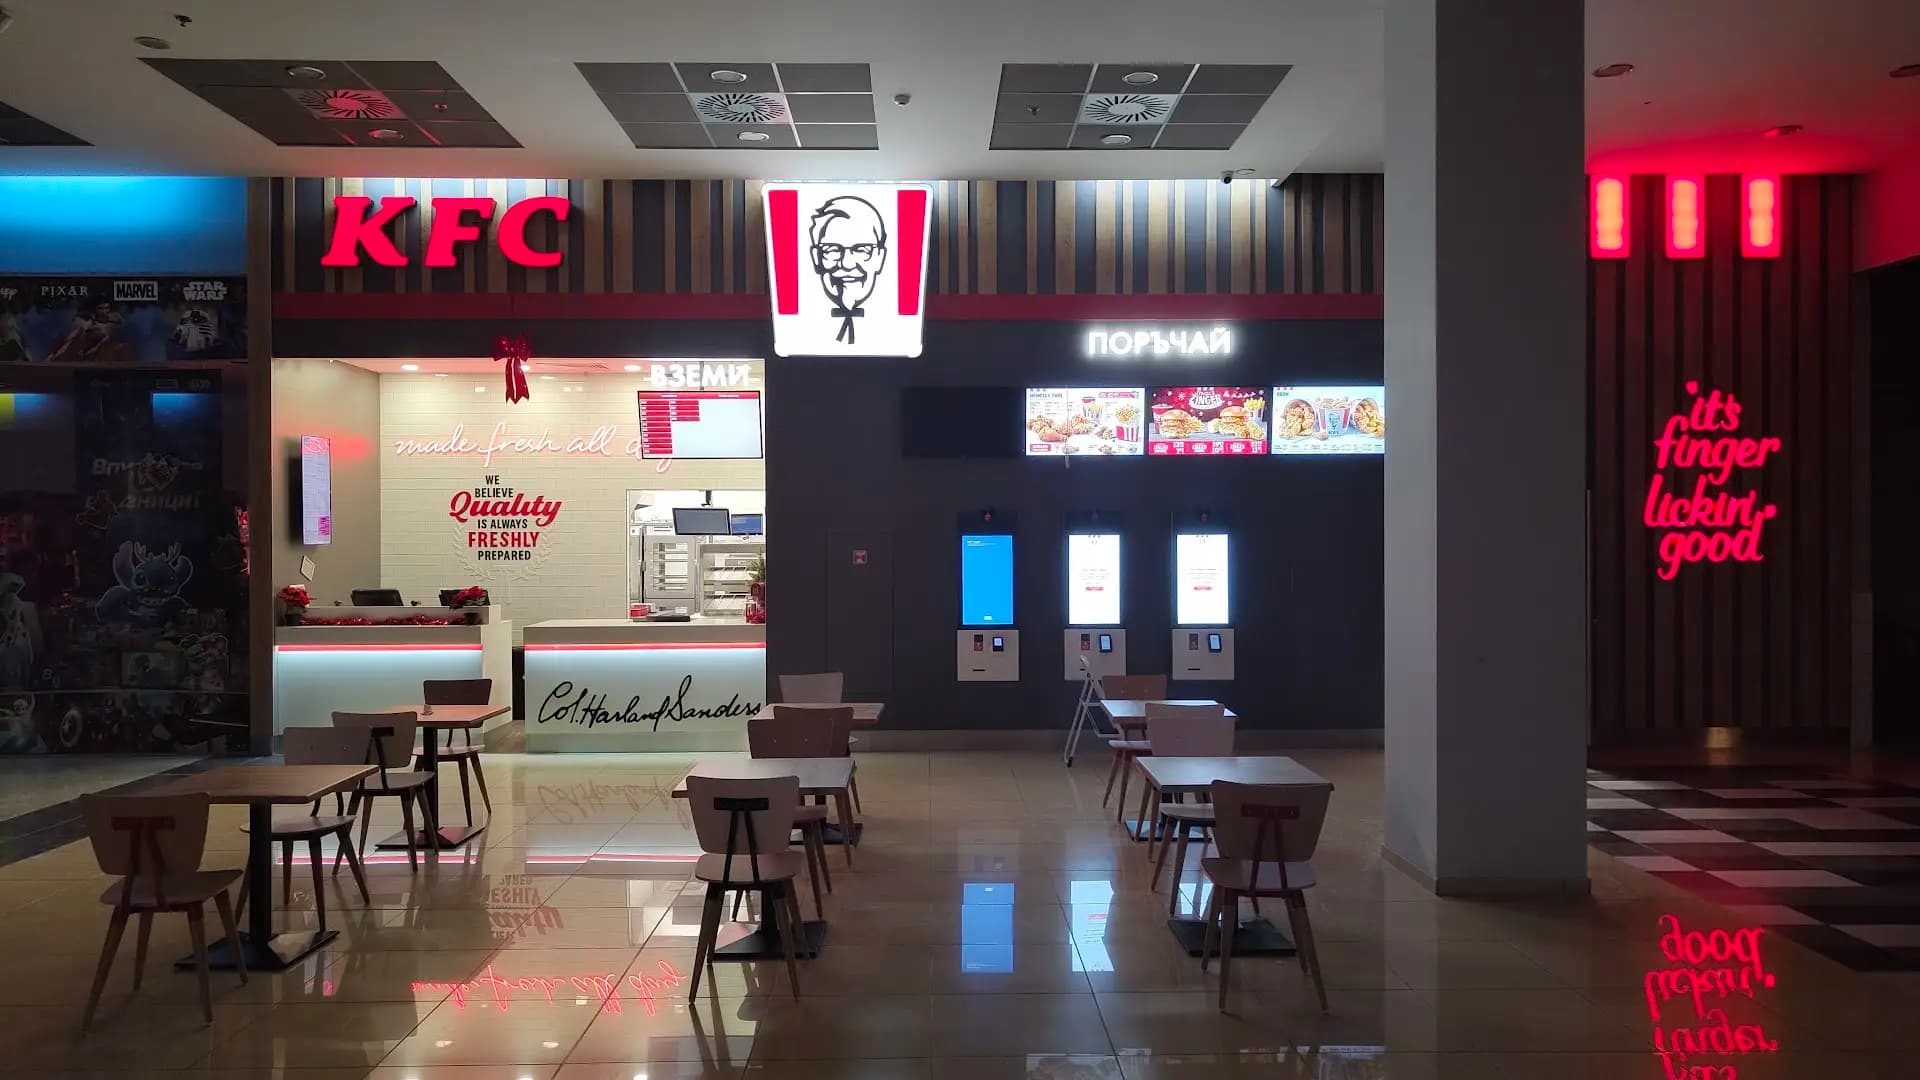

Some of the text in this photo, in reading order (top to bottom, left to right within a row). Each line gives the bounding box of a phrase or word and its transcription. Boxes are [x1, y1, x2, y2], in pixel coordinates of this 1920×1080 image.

[321, 196, 570, 267] KFC
[41, 285, 89, 297] PIXAR
[115, 282, 157, 299] MARVEL
[183, 281, 227, 291] STAR
[183, 290, 227, 300] WARS
[1088, 326, 1231, 355] ПОРЪЧАЙ
[650, 364, 752, 387] ВЗЕМИ
[394, 424, 478, 456] made
[478, 422, 561, 467] fresh
[566, 426, 617, 456] all
[1654, 415, 1782, 485] finger
[485, 475, 500, 485] WE
[474, 488, 514, 498] BELIEVE
[449, 490, 562, 527] Quality
[477, 518, 528, 529] IS ALWAYS
[468, 531, 540, 548] FRESHLY
[1657, 511, 1764, 581] good
[478, 550, 531, 561] PREPARED
